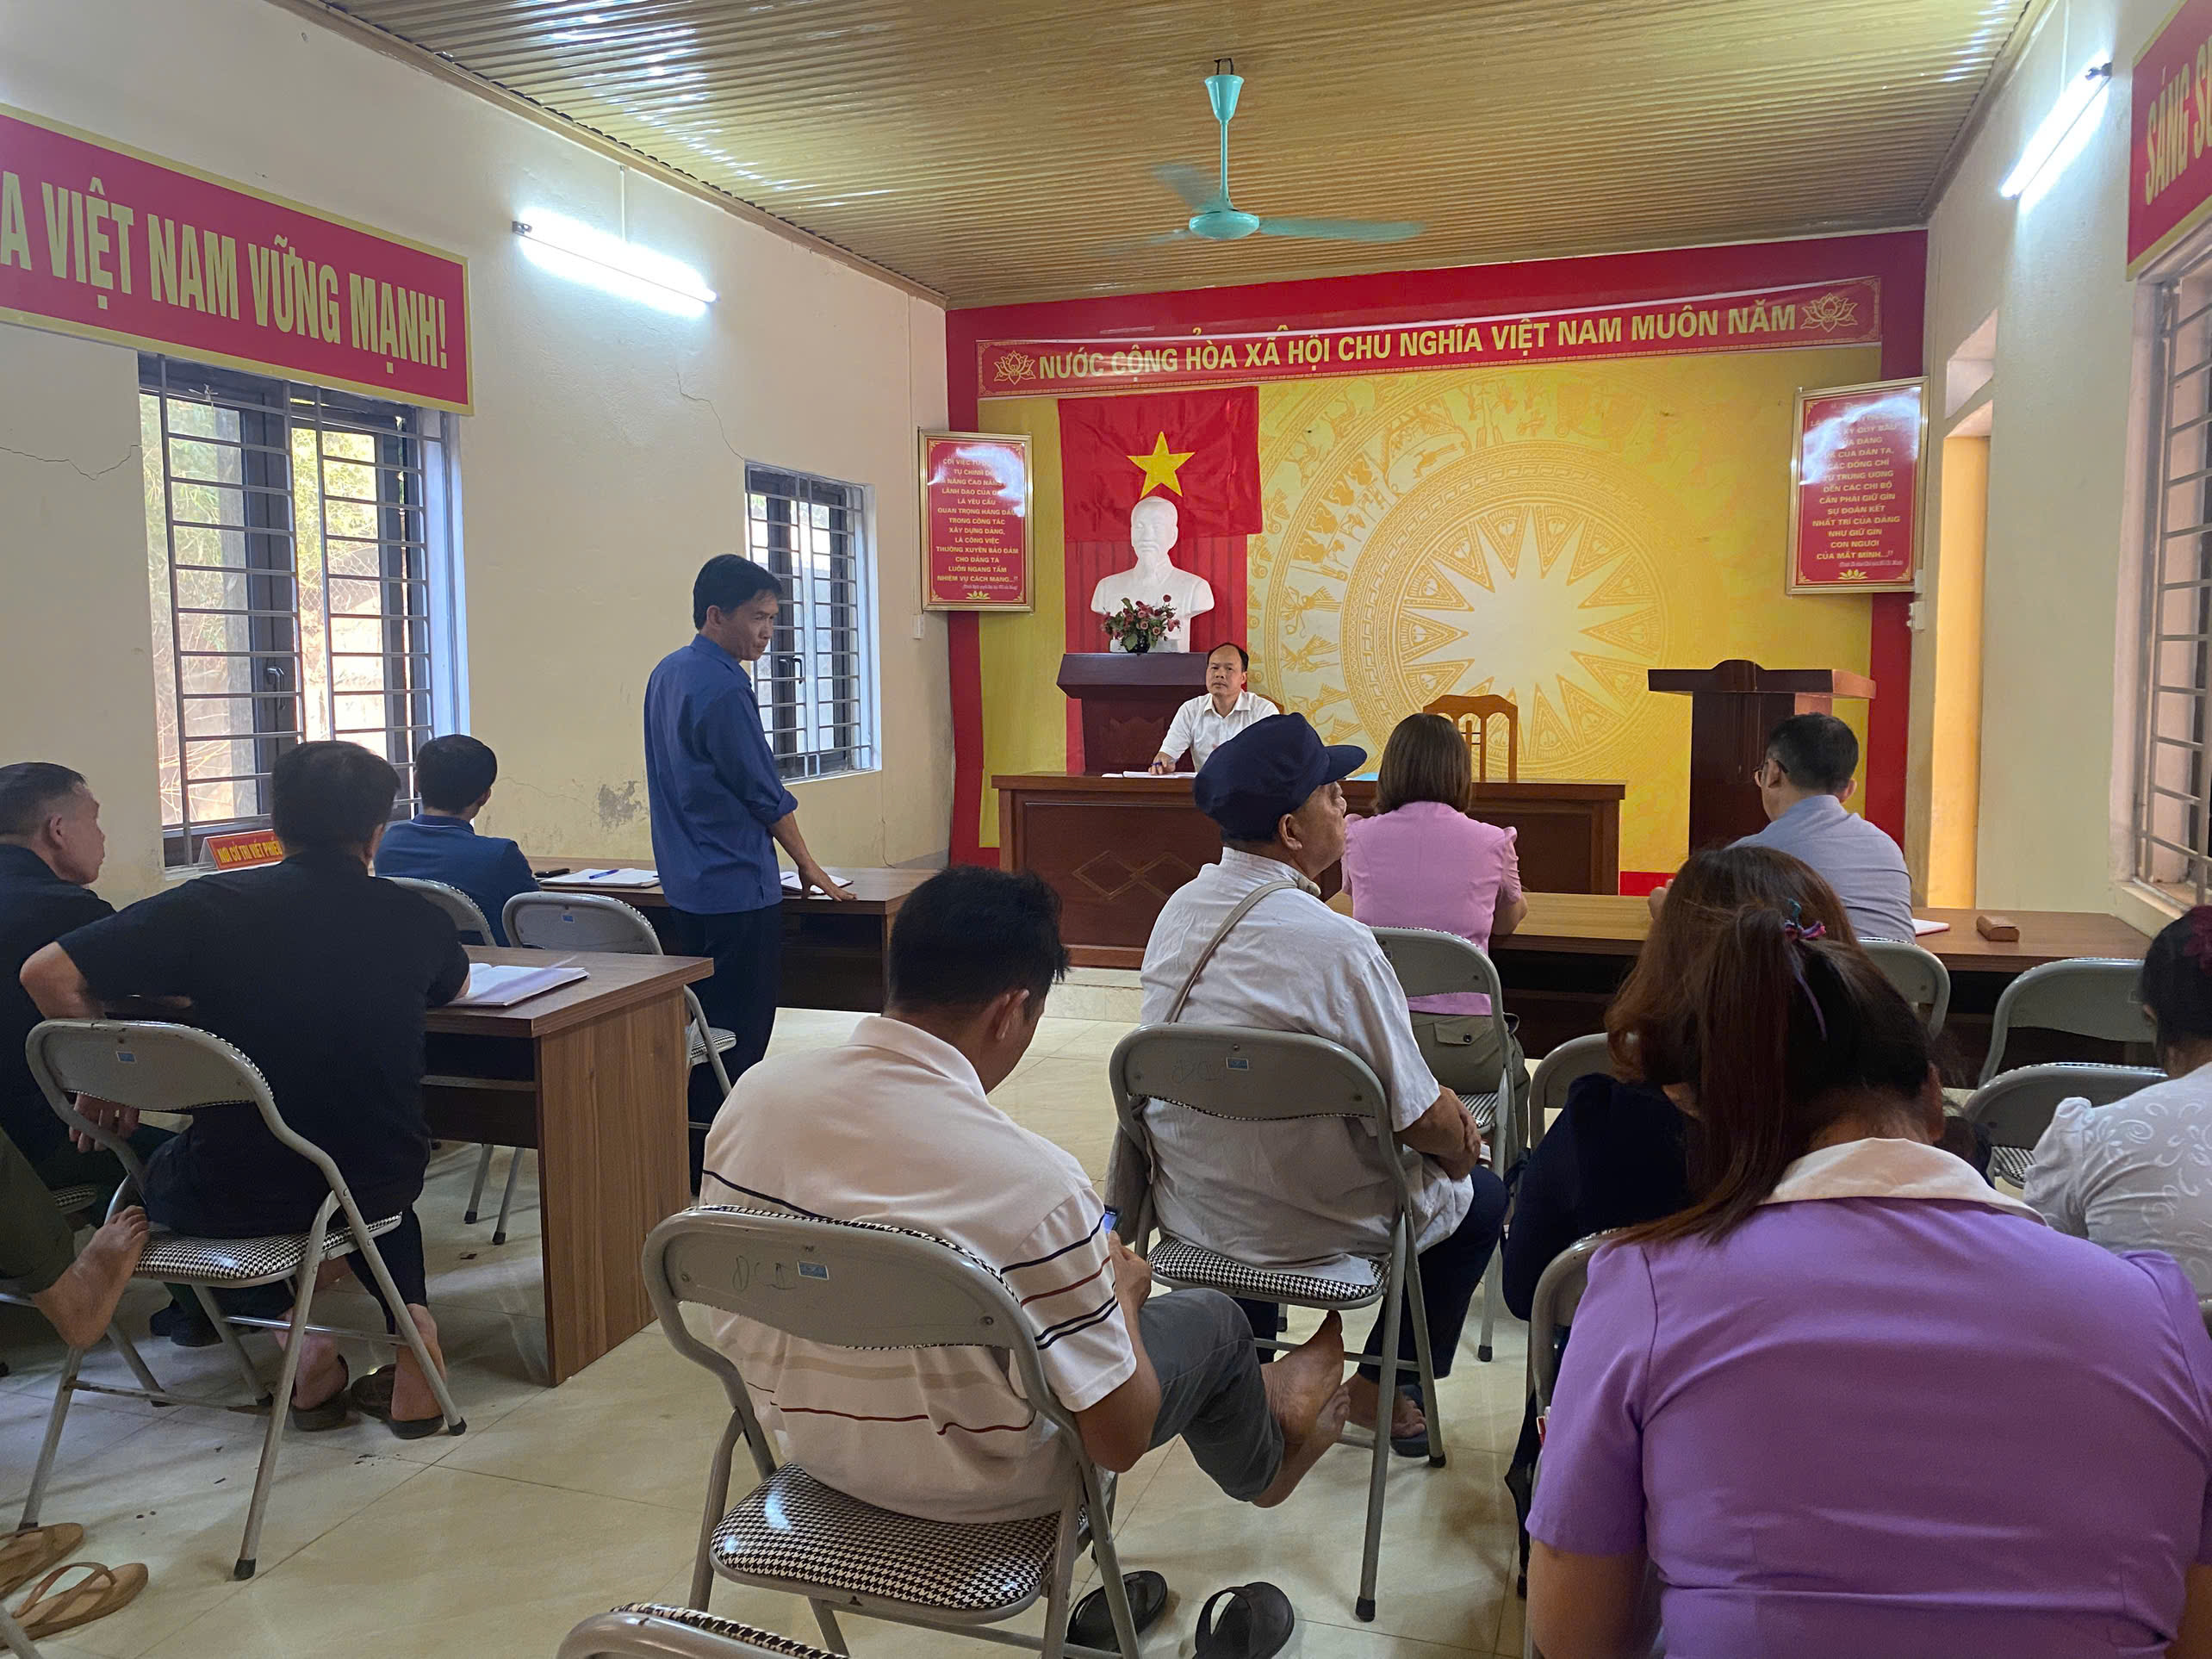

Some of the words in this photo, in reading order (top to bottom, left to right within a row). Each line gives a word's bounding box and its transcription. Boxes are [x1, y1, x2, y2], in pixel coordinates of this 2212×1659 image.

[2146, 63, 2190, 206] SÁNG
[41, 177, 134, 310] VIỆT
[147, 213, 240, 320] NAM
[248, 233, 341, 345] VỮNG
[349, 272, 448, 374] MẠNH!
[1040, 346, 1104, 379] NƯỚC
[1111, 344, 1178, 382] CỘNG
[1186, 339, 1238, 371] HÒA
[1245, 336, 1281, 368] XÃ
[1288, 333, 1330, 372] HỘI
[1399, 324, 1483, 357] NGHĨA
[1491, 318, 1550, 357] VIỆT
[1557, 317, 1622, 346] NAM
[1631, 304, 1718, 341] MUÔN
[1728, 298, 1796, 335] NĂM
